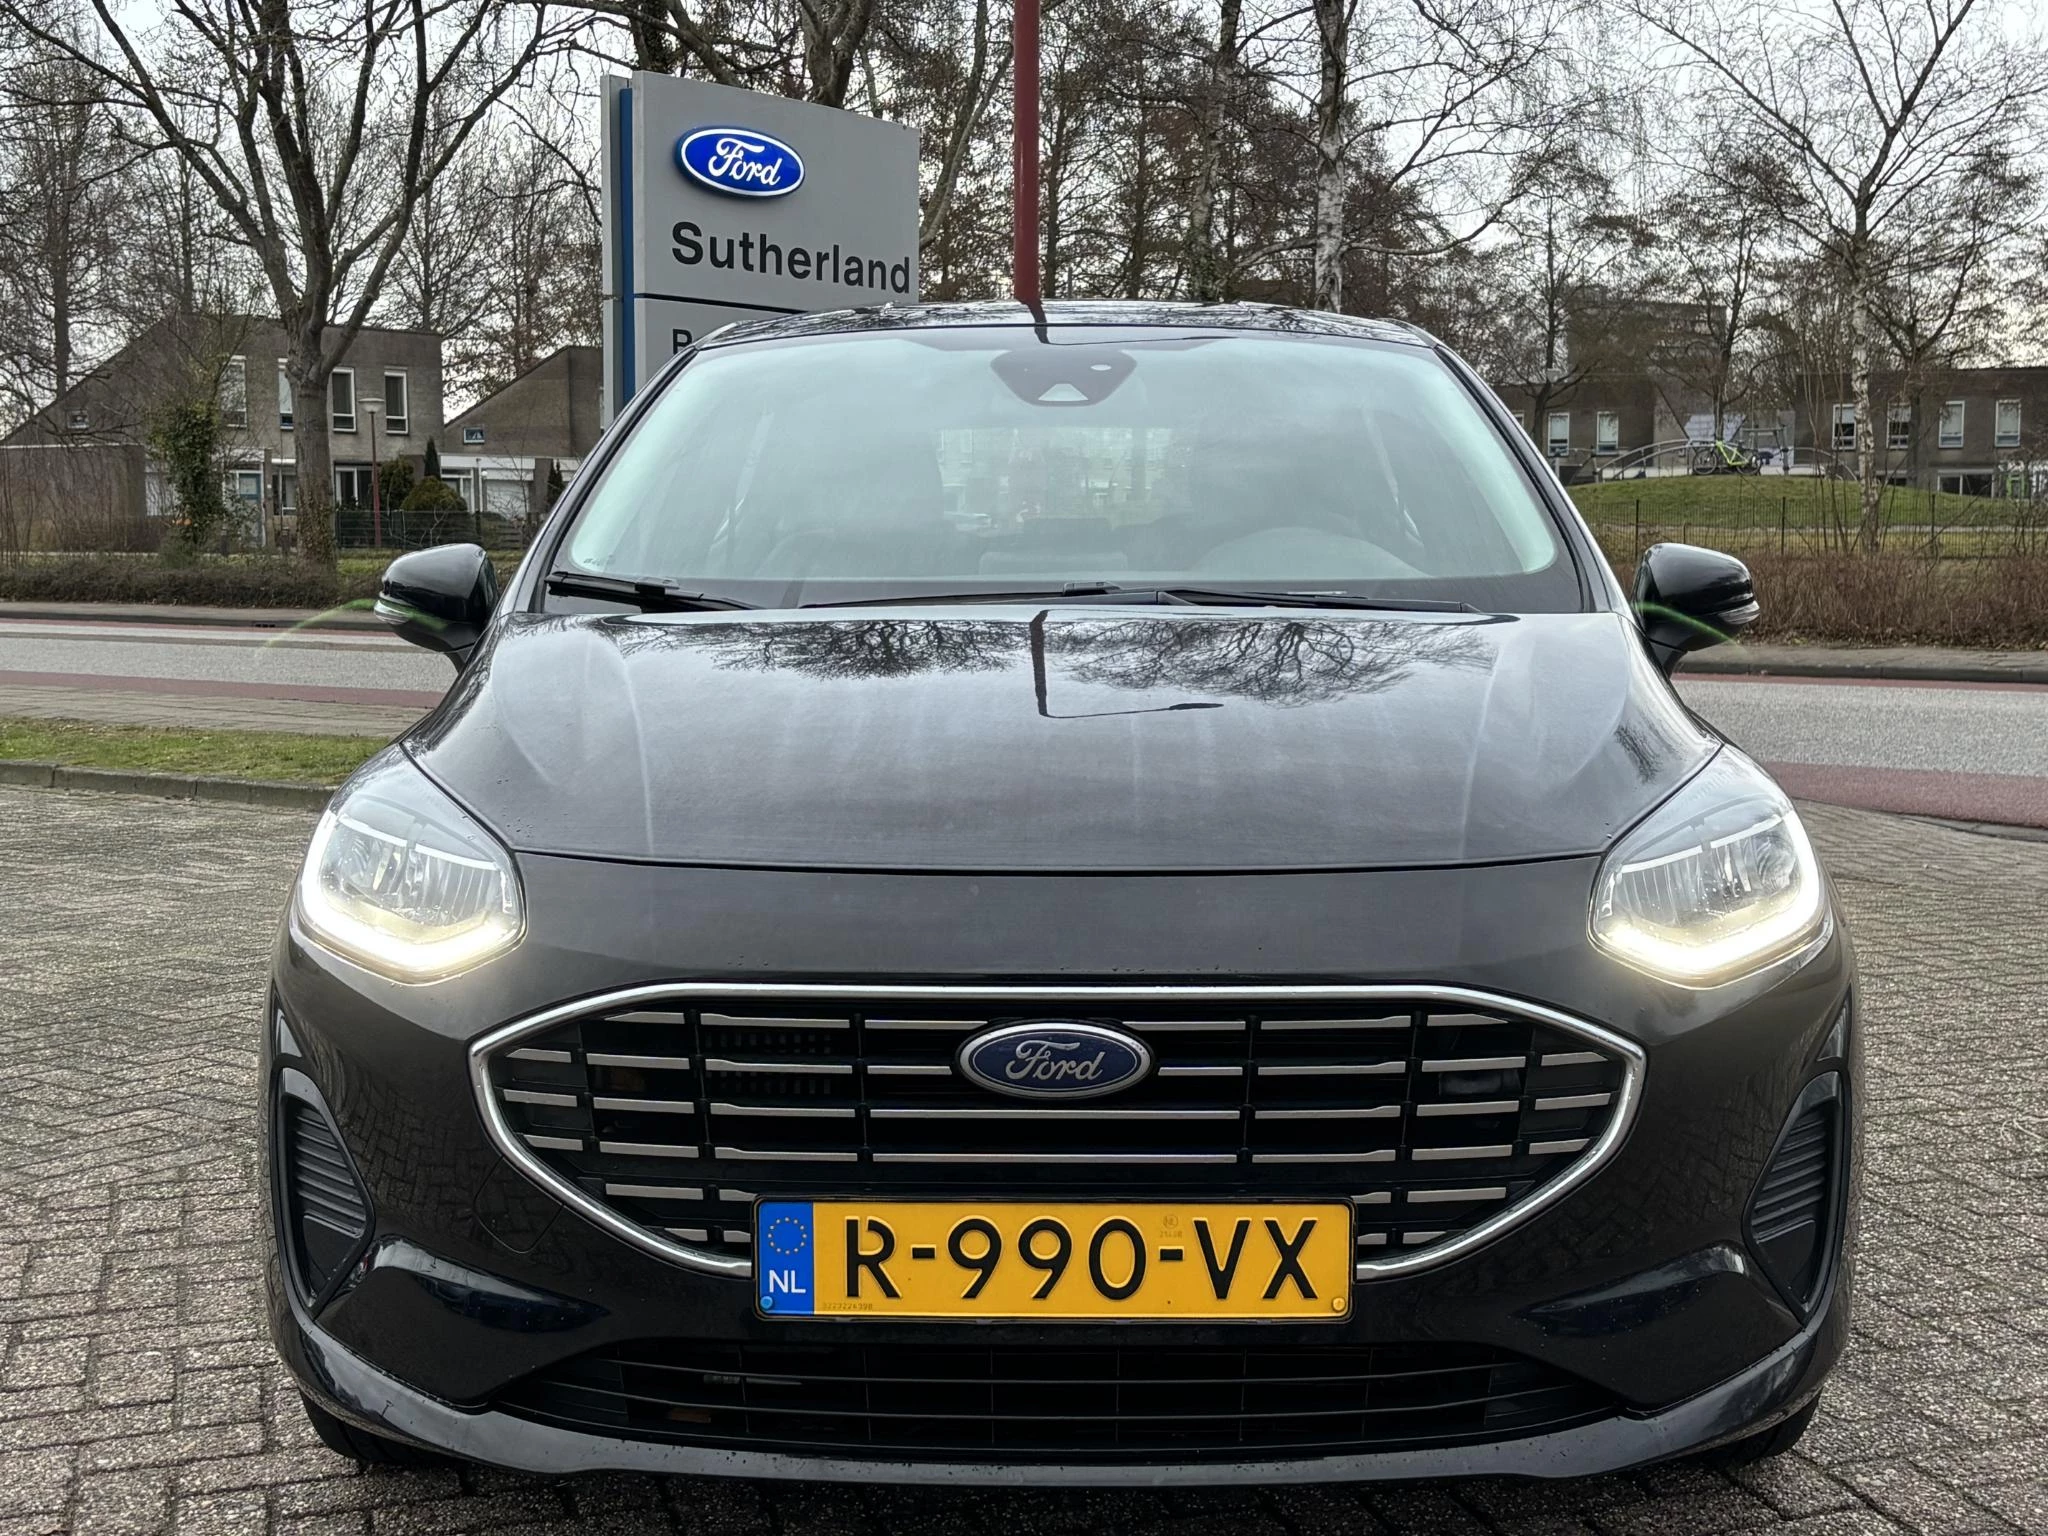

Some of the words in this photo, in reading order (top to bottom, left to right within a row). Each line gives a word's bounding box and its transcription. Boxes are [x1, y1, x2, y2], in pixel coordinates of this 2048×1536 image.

[708, 138, 783, 186] Ford
[671, 221, 910, 294] Sutherland
[1005, 1039, 1106, 1080] Ford
[769, 1269, 806, 1293] NL
[844, 1215, 1319, 1300] R-990-VX
